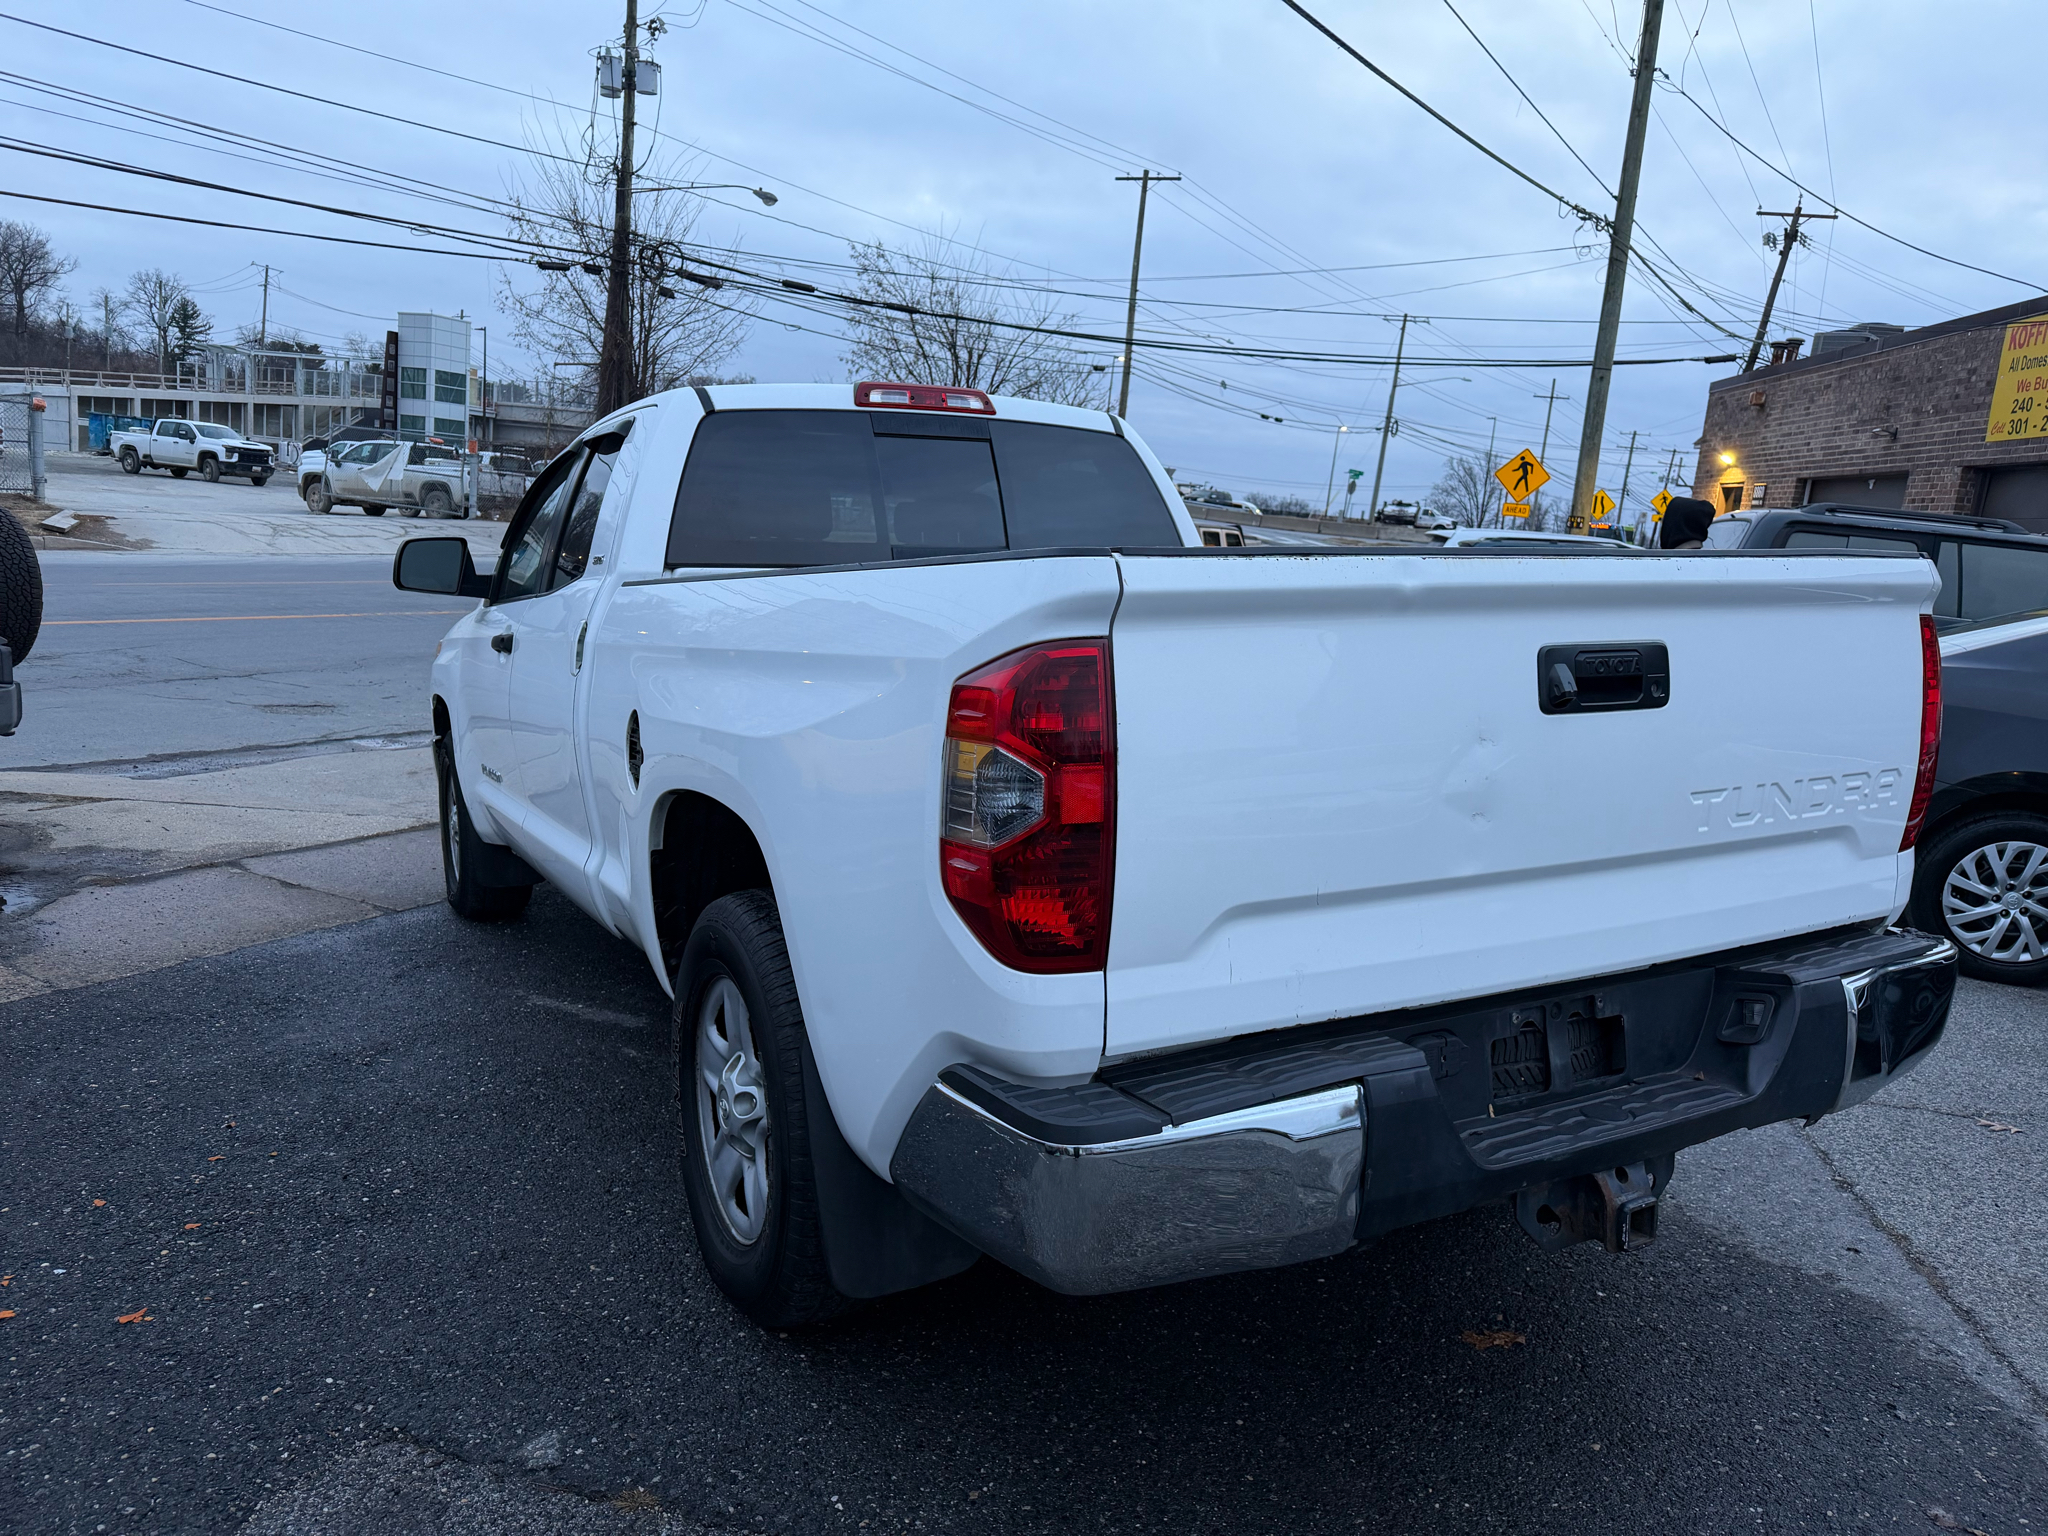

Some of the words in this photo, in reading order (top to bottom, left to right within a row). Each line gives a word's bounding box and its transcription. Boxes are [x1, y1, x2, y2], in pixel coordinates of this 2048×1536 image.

[2008, 356, 2021, 373] All
[2021, 354, 2048, 371] Domes
[2017, 379, 2031, 393] We
[2011, 397, 2034, 414] 240
[1991, 421, 2006, 436] Cell
[2007, 417, 2029, 435] 301
[1504, 506, 1527, 515] AHEAD
[1585, 657, 1641, 674] TOYOTA
[1690, 768, 1902, 832] TUNDRA
